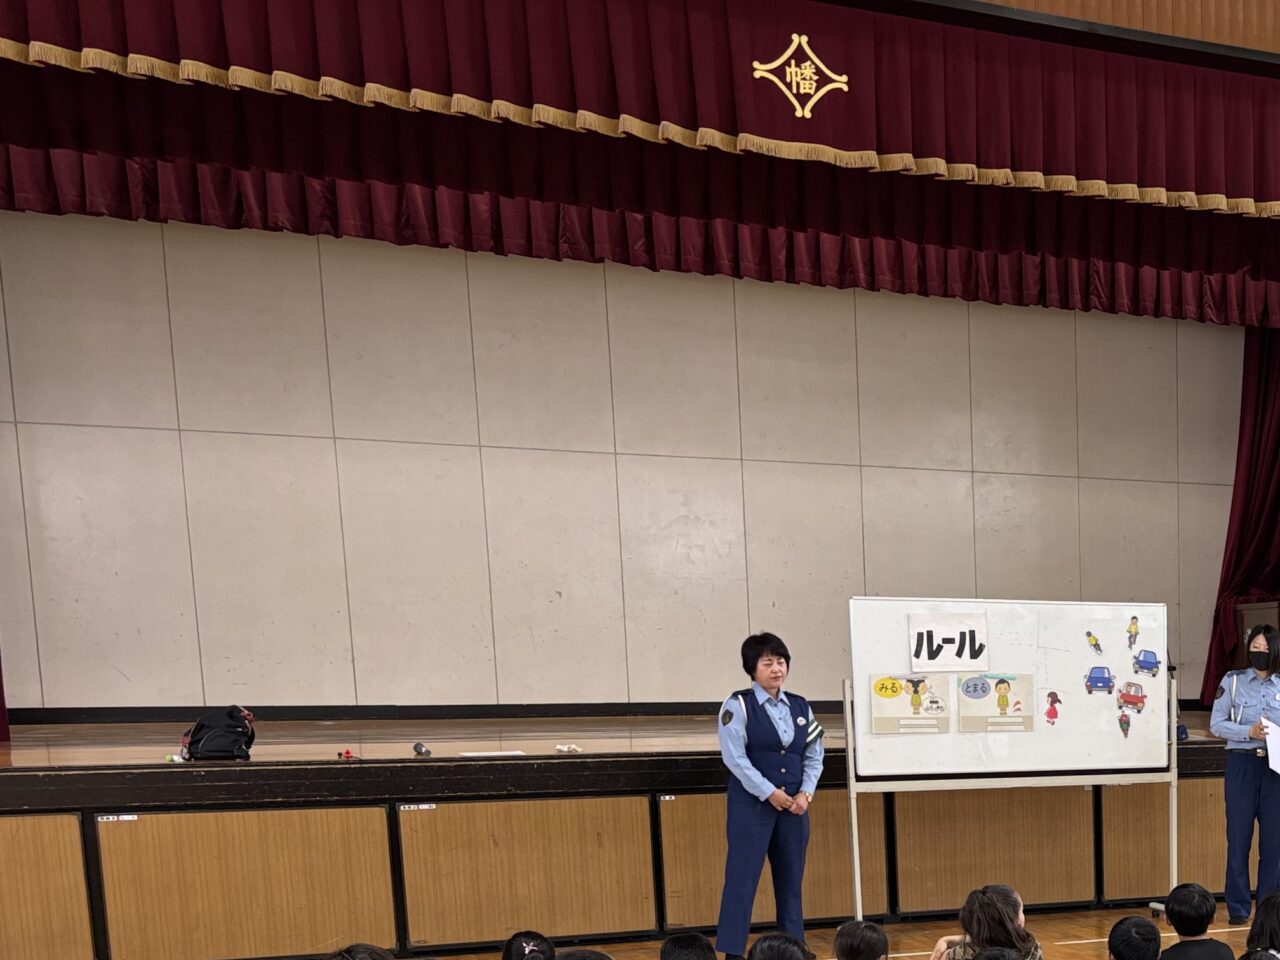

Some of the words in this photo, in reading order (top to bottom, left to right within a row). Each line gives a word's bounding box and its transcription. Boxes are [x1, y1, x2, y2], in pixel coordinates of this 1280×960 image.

[785, 59, 820, 95] 幡
[913, 629, 986, 661] ルール
[878, 682, 899, 693] みる
[965, 683, 987, 694] とまる
